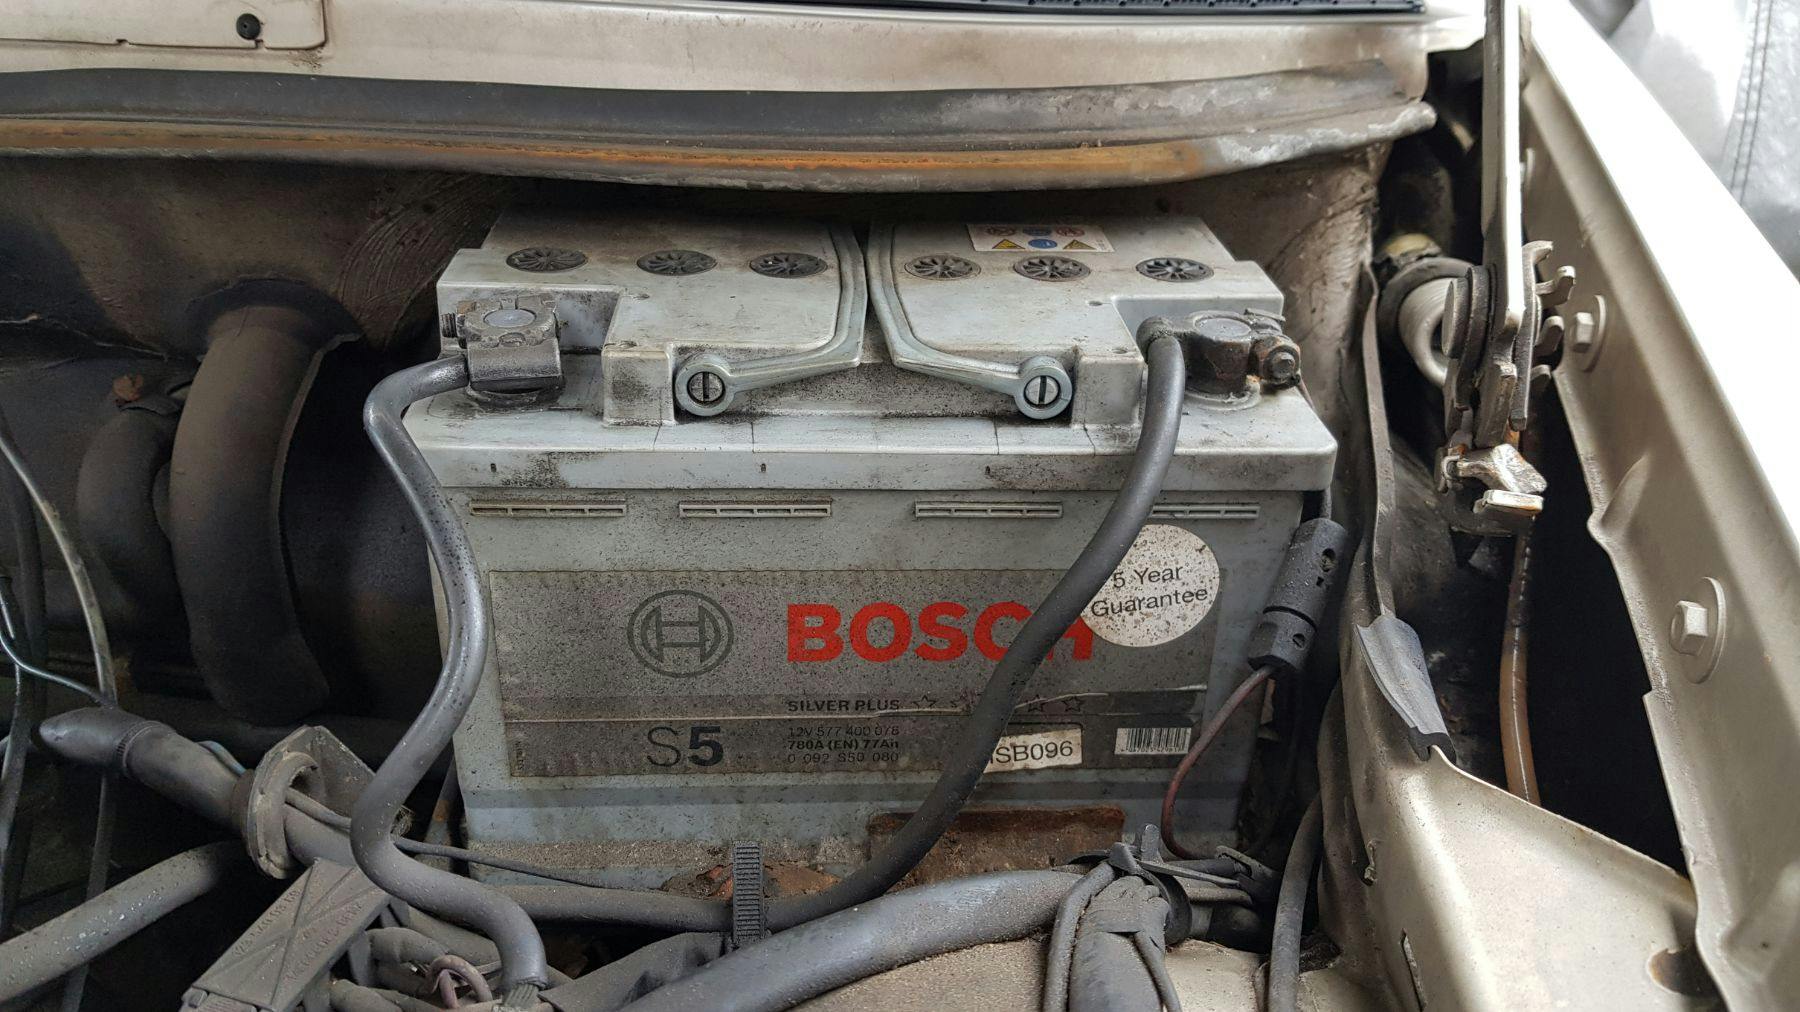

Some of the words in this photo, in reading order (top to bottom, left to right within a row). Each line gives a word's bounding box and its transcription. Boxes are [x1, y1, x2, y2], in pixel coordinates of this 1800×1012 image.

[1113, 571, 1126, 588] 5
[1134, 566, 1183, 584] Year
[1091, 588, 1208, 617] Guarantee
[788, 701, 850, 712] SILVER
[855, 700, 900, 711] PLUS
[816, 726, 842, 737] 577
[846, 726, 871, 736] 400
[788, 740, 824, 750] 780A
[828, 739, 859, 751] (EN)
